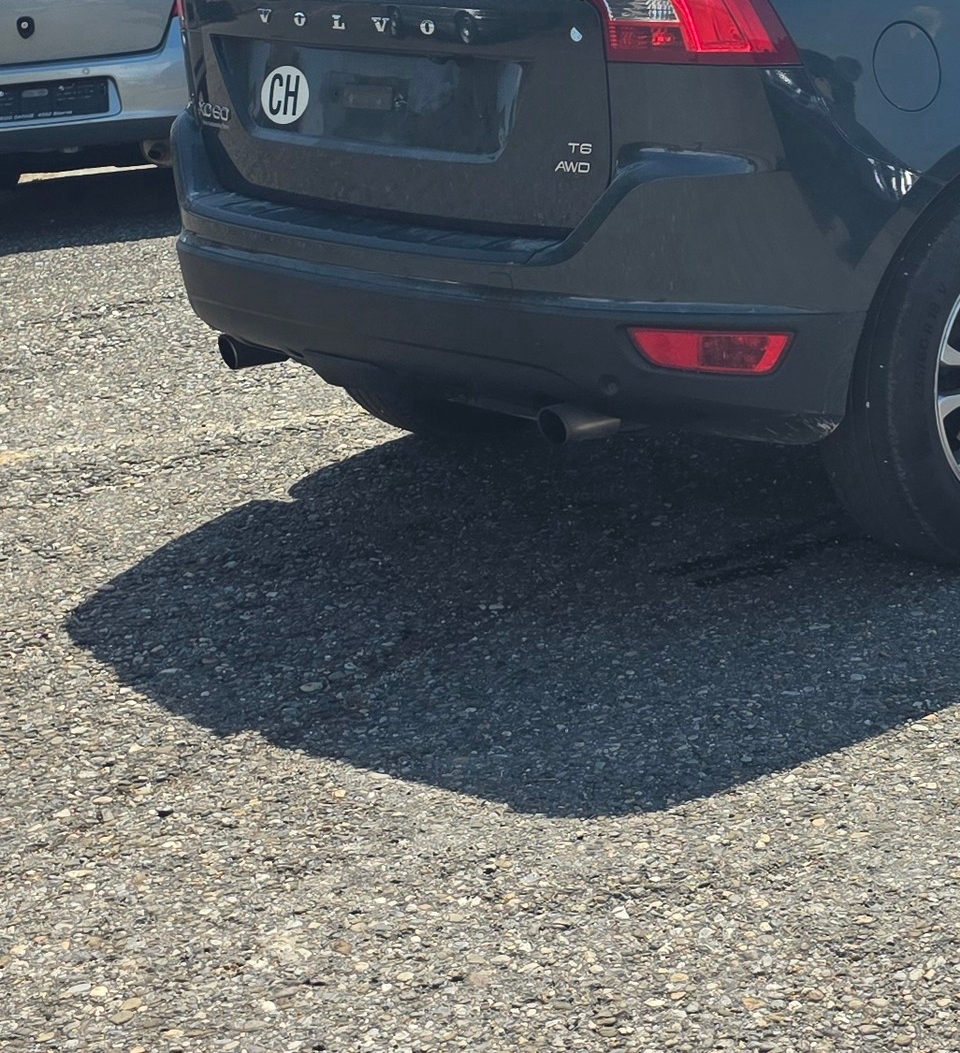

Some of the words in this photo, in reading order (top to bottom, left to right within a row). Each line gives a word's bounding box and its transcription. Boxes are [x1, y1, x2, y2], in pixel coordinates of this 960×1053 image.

[257, 8, 436, 36] VOLVO
[269, 73, 300, 116] CH
[567, 142, 592, 154] T6
[554, 160, 591, 173] AWD
